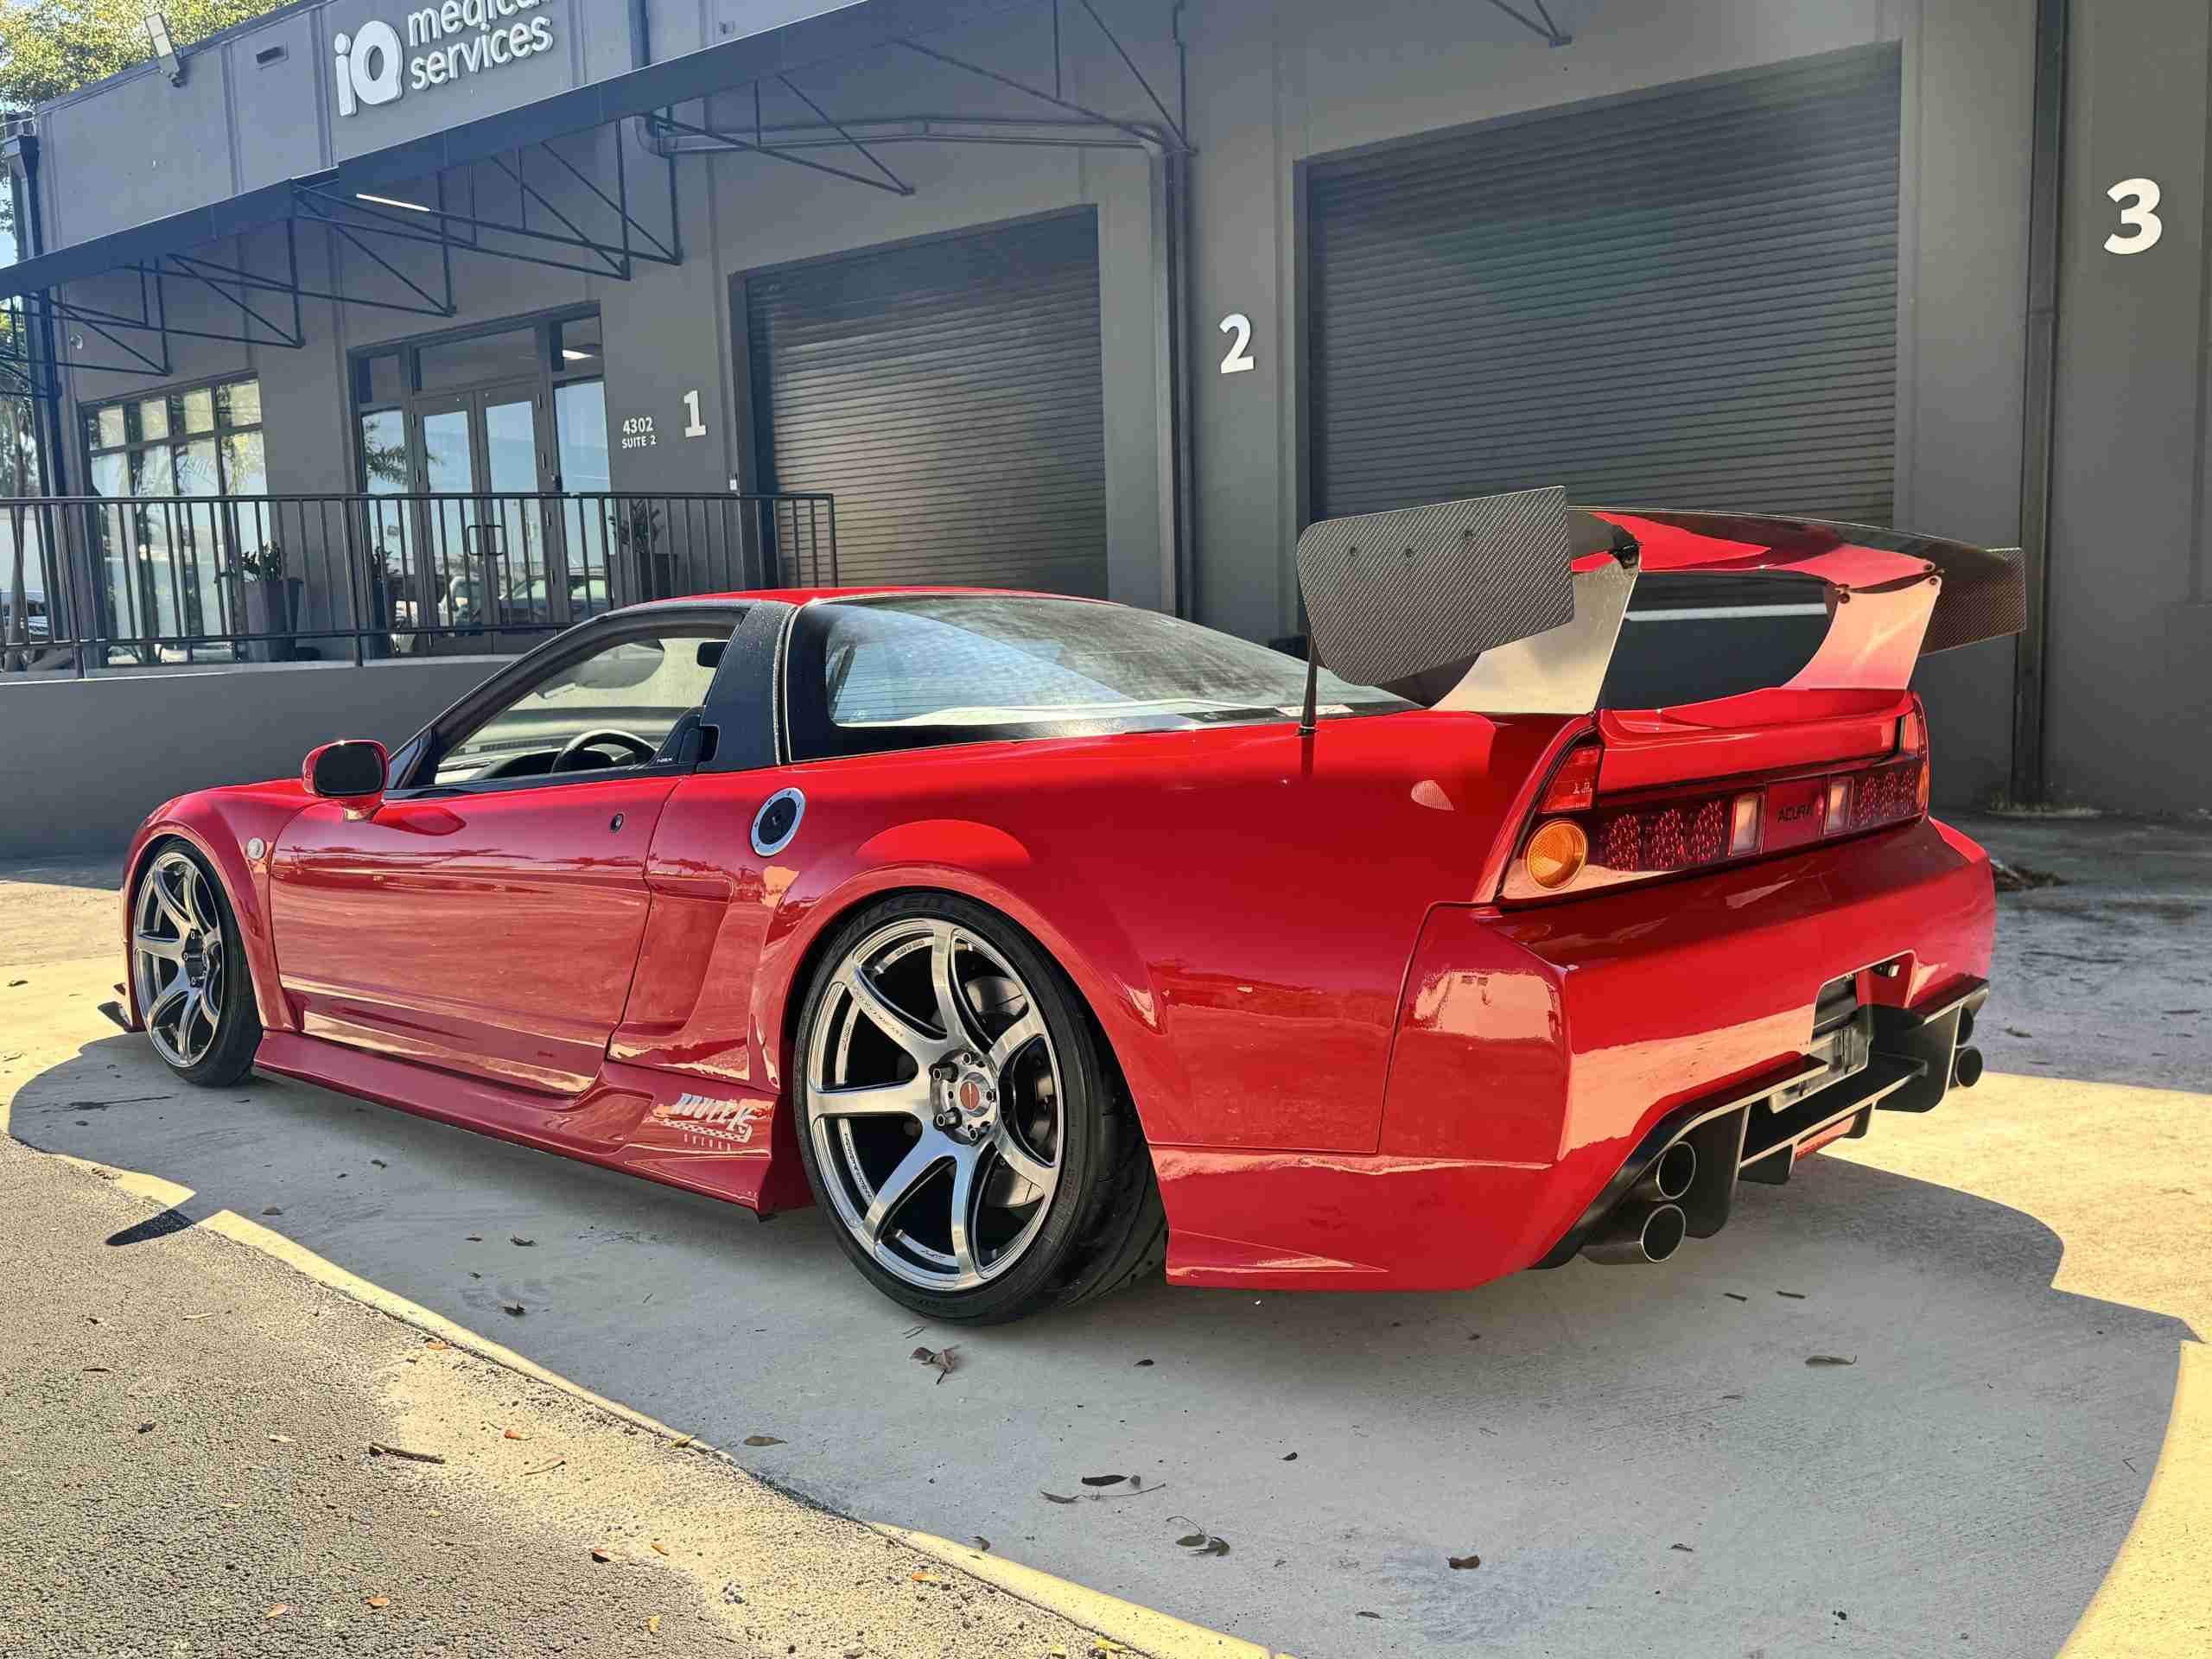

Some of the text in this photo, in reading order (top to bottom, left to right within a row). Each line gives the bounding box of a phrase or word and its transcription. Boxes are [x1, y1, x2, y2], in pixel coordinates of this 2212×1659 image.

[407, 0, 550, 47] medic
[410, 16, 554, 90] services
[2103, 177, 2162, 255] 3
[1219, 313, 1254, 374] 2
[622, 416, 654, 435] 4302
[683, 390, 707, 438] 1
[622, 435, 657, 449] SUITE 2
[1776, 804, 1813, 823] ACURA
